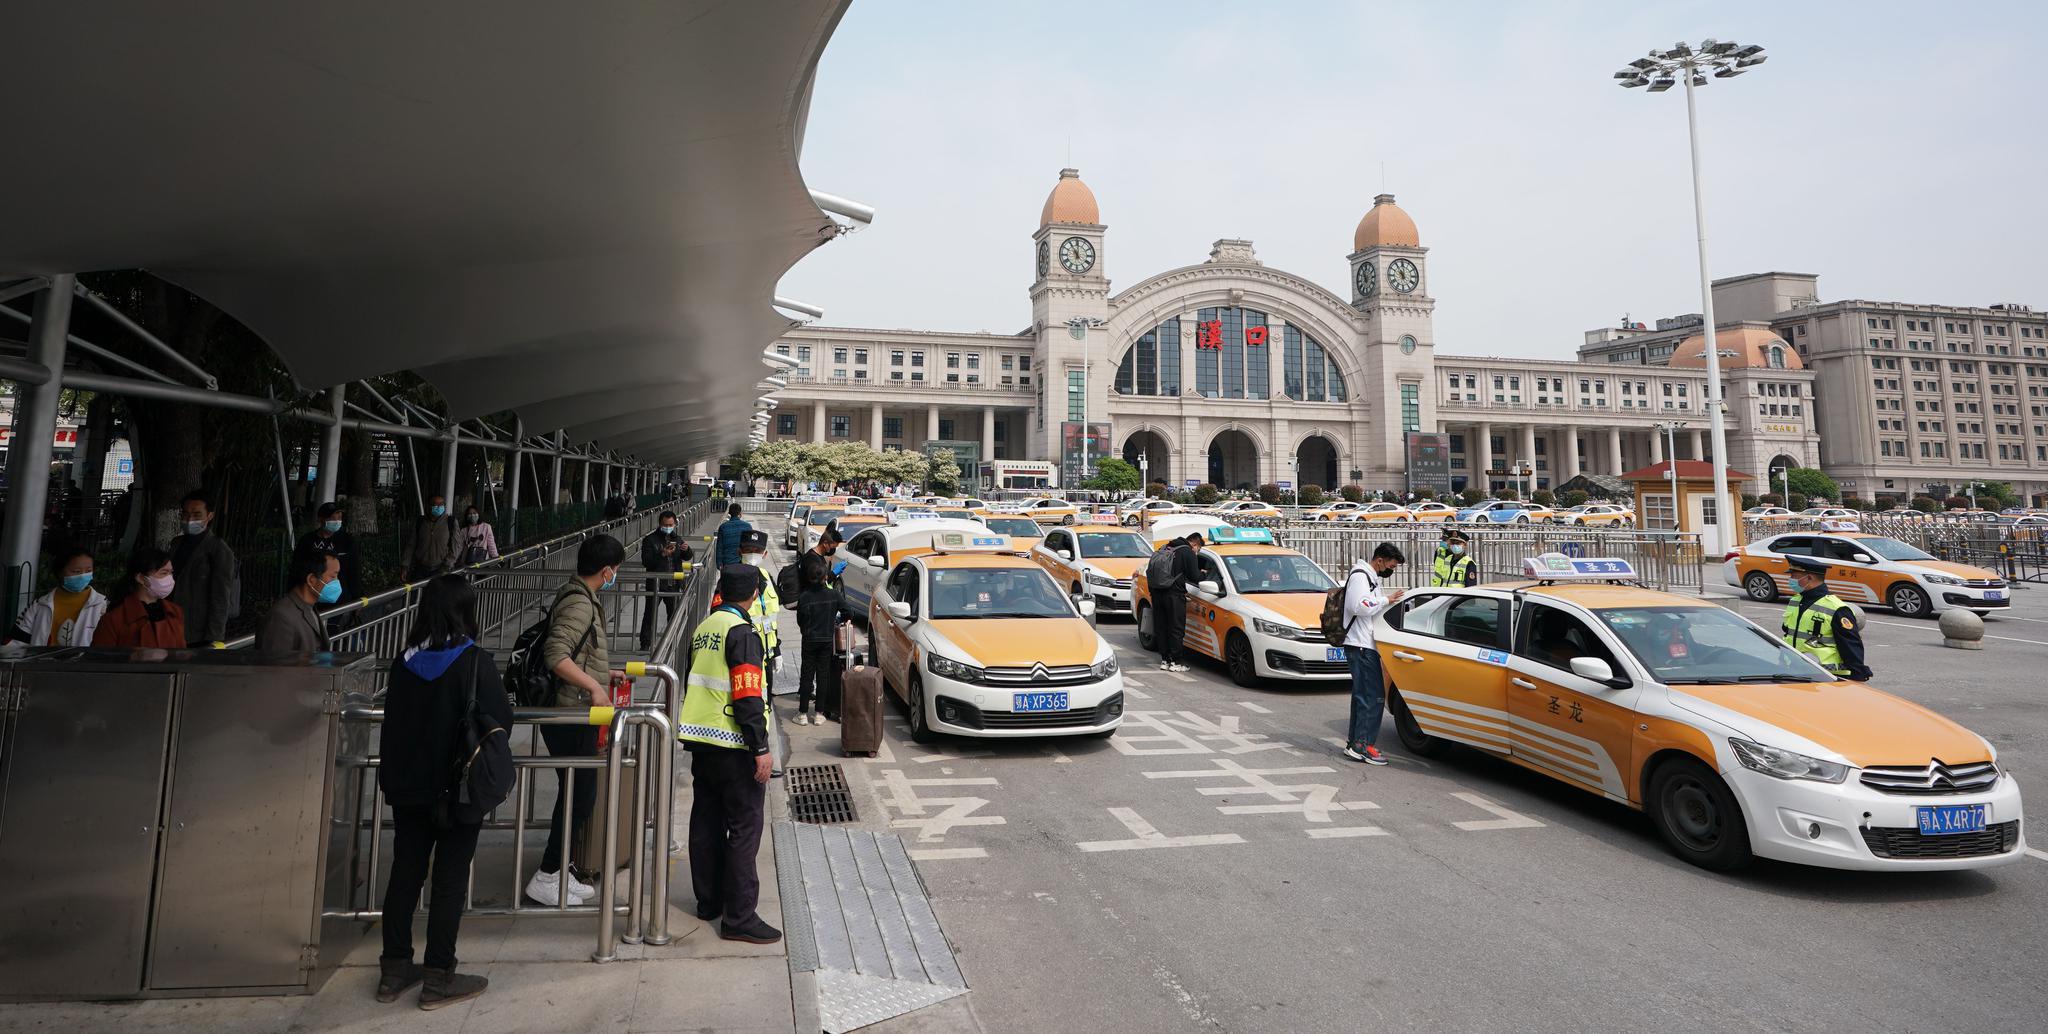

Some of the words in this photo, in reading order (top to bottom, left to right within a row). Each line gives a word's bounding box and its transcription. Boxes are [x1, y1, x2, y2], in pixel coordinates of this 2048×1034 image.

[1199, 319, 1268, 350] 漢口
[1584, 562, 1621, 572] 圣龙
[692, 632, 721, 651] 合执法
[733, 671, 760, 692] 汉管家
[1548, 696, 1583, 723] 圣龙
